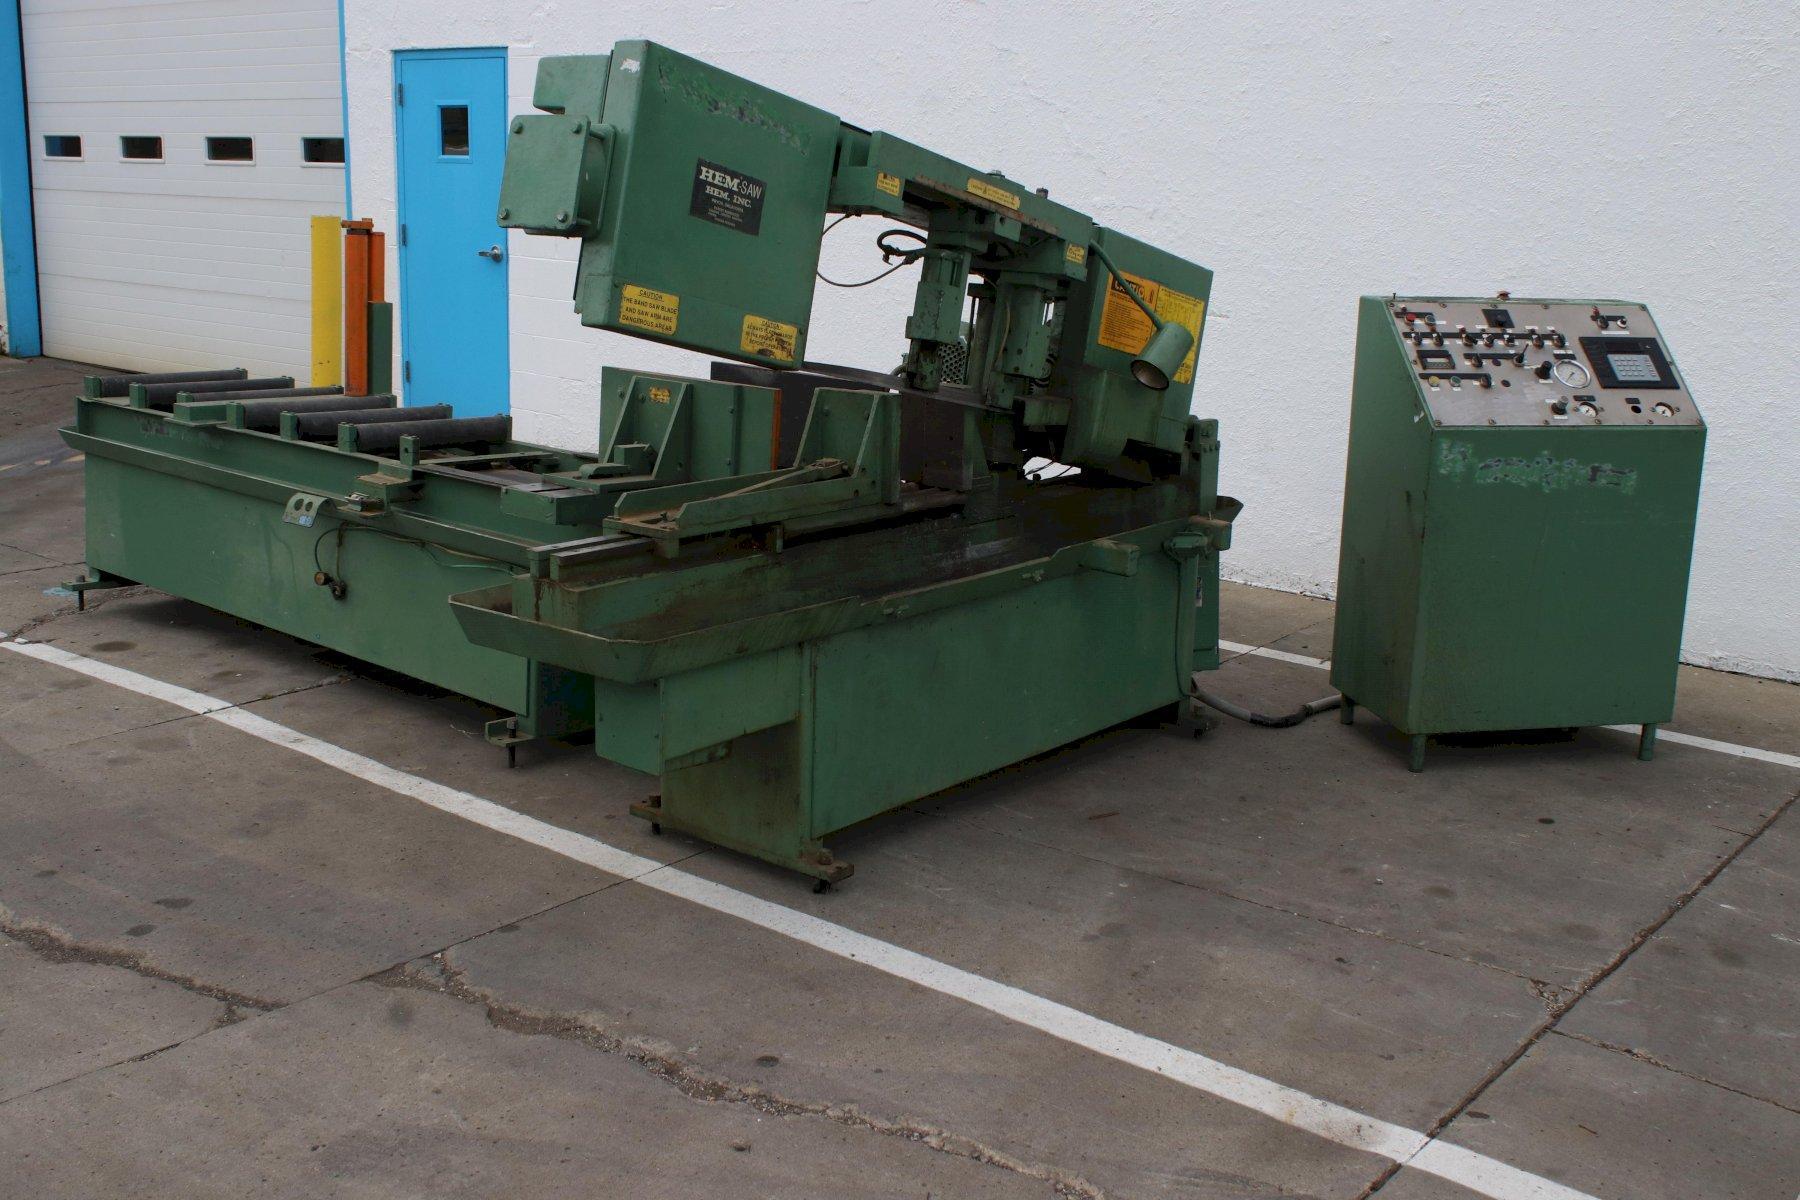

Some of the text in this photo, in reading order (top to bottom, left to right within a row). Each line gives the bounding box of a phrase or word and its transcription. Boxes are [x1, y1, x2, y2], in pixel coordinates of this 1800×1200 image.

[705, 185, 730, 201] HEM,
[733, 195, 752, 208] INC.
[661, 305, 678, 315] BLADE
